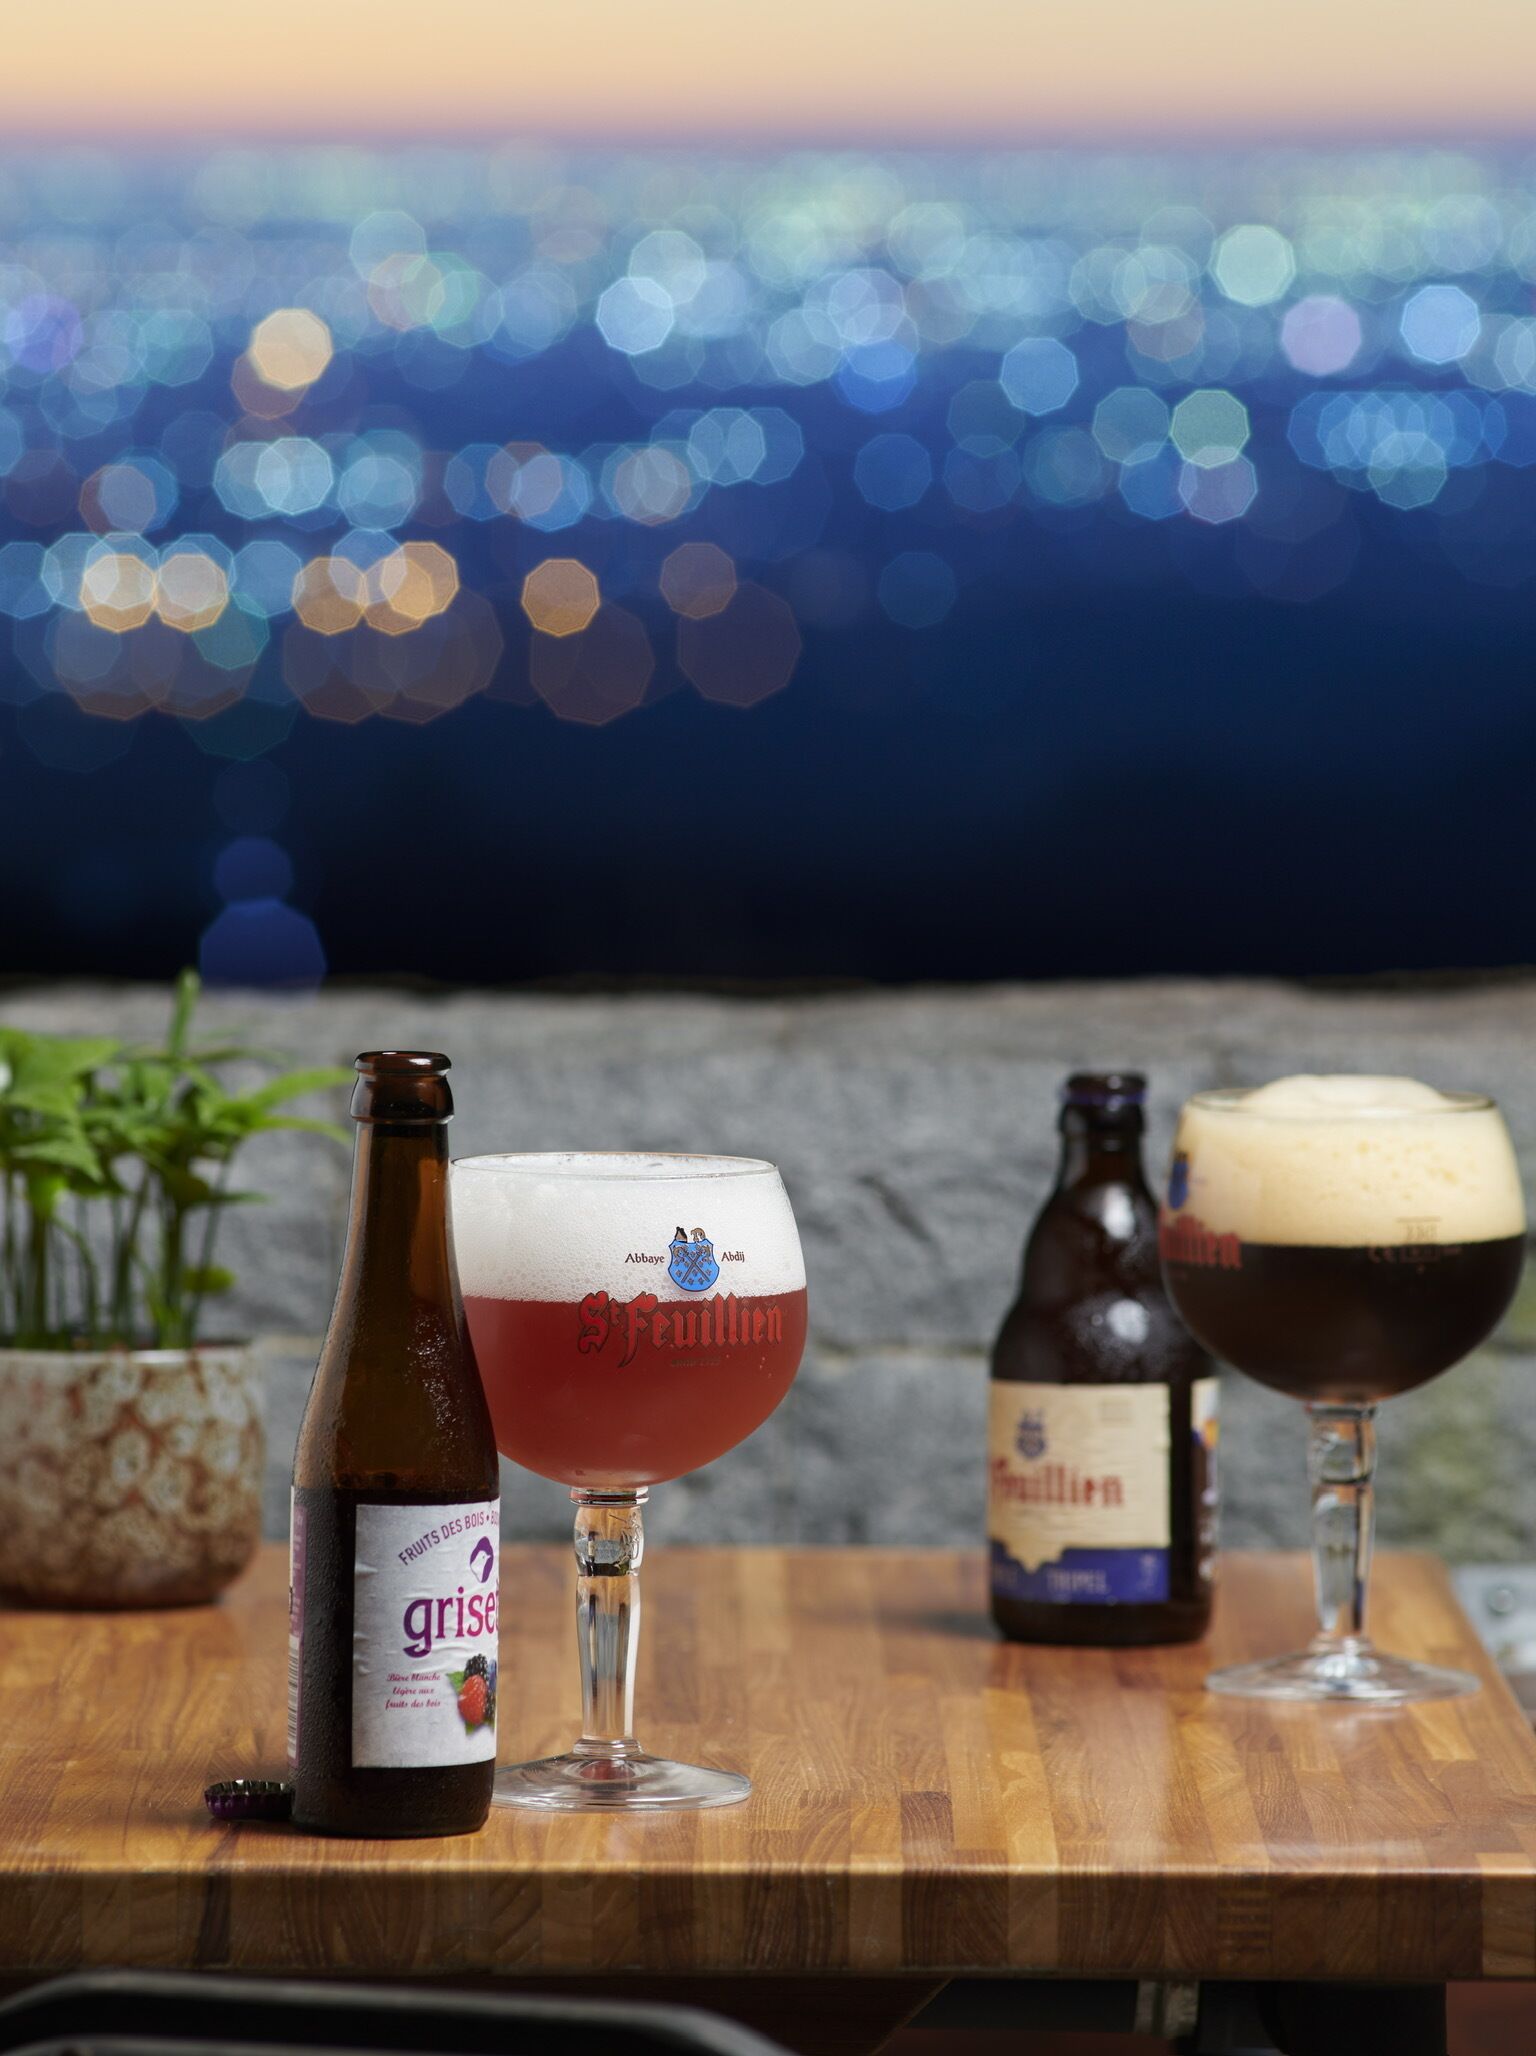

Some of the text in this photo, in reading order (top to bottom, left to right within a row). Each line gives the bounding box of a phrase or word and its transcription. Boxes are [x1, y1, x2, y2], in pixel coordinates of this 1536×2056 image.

[625, 1250, 745, 1264] Abbaye Abdij
[617, 1291, 783, 1368] Feuillien
[398, 1530, 440, 1566] FRUITS
[441, 1518, 463, 1540] DES
[464, 1511, 485, 1529] BOIS
[403, 1586, 499, 1658] grise
[385, 1699, 440, 1710] fruits des bois
